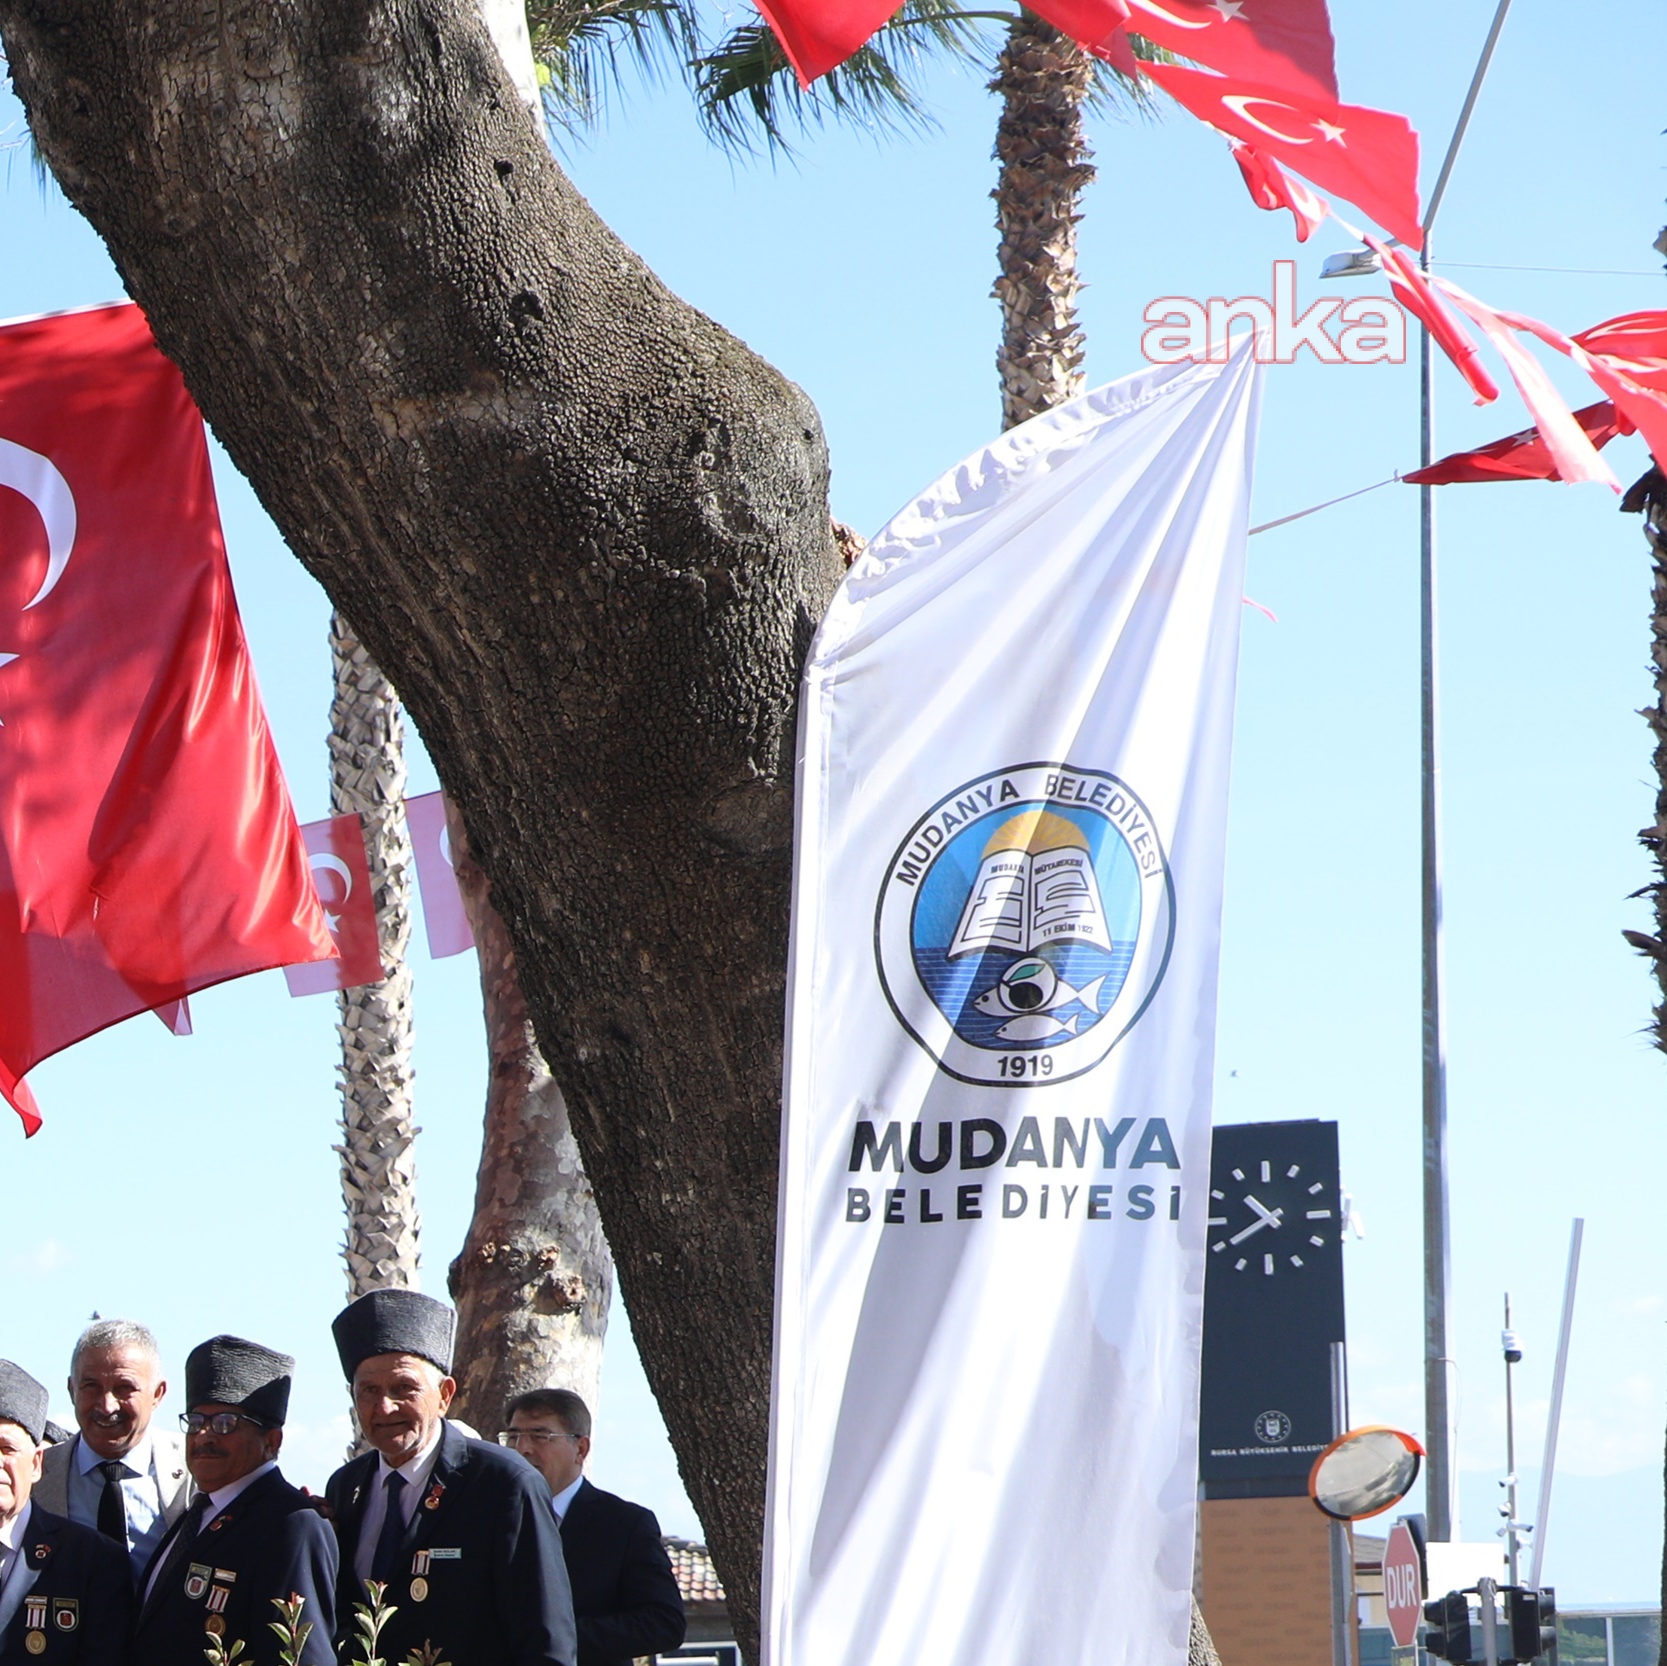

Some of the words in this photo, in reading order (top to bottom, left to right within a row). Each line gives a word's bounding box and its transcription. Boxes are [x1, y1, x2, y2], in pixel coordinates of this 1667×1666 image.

[896, 779, 1020, 887] MUDANYA
[1045, 774, 1163, 879] BELEDİYESİ
[1043, 928, 1052, 937] 11
[996, 1054, 1054, 1079] 1919
[847, 1117, 1181, 1175] MUDANYA
[846, 1184, 1181, 1225] BELEDİYESİ
[1386, 1563, 1417, 1610] DUR
